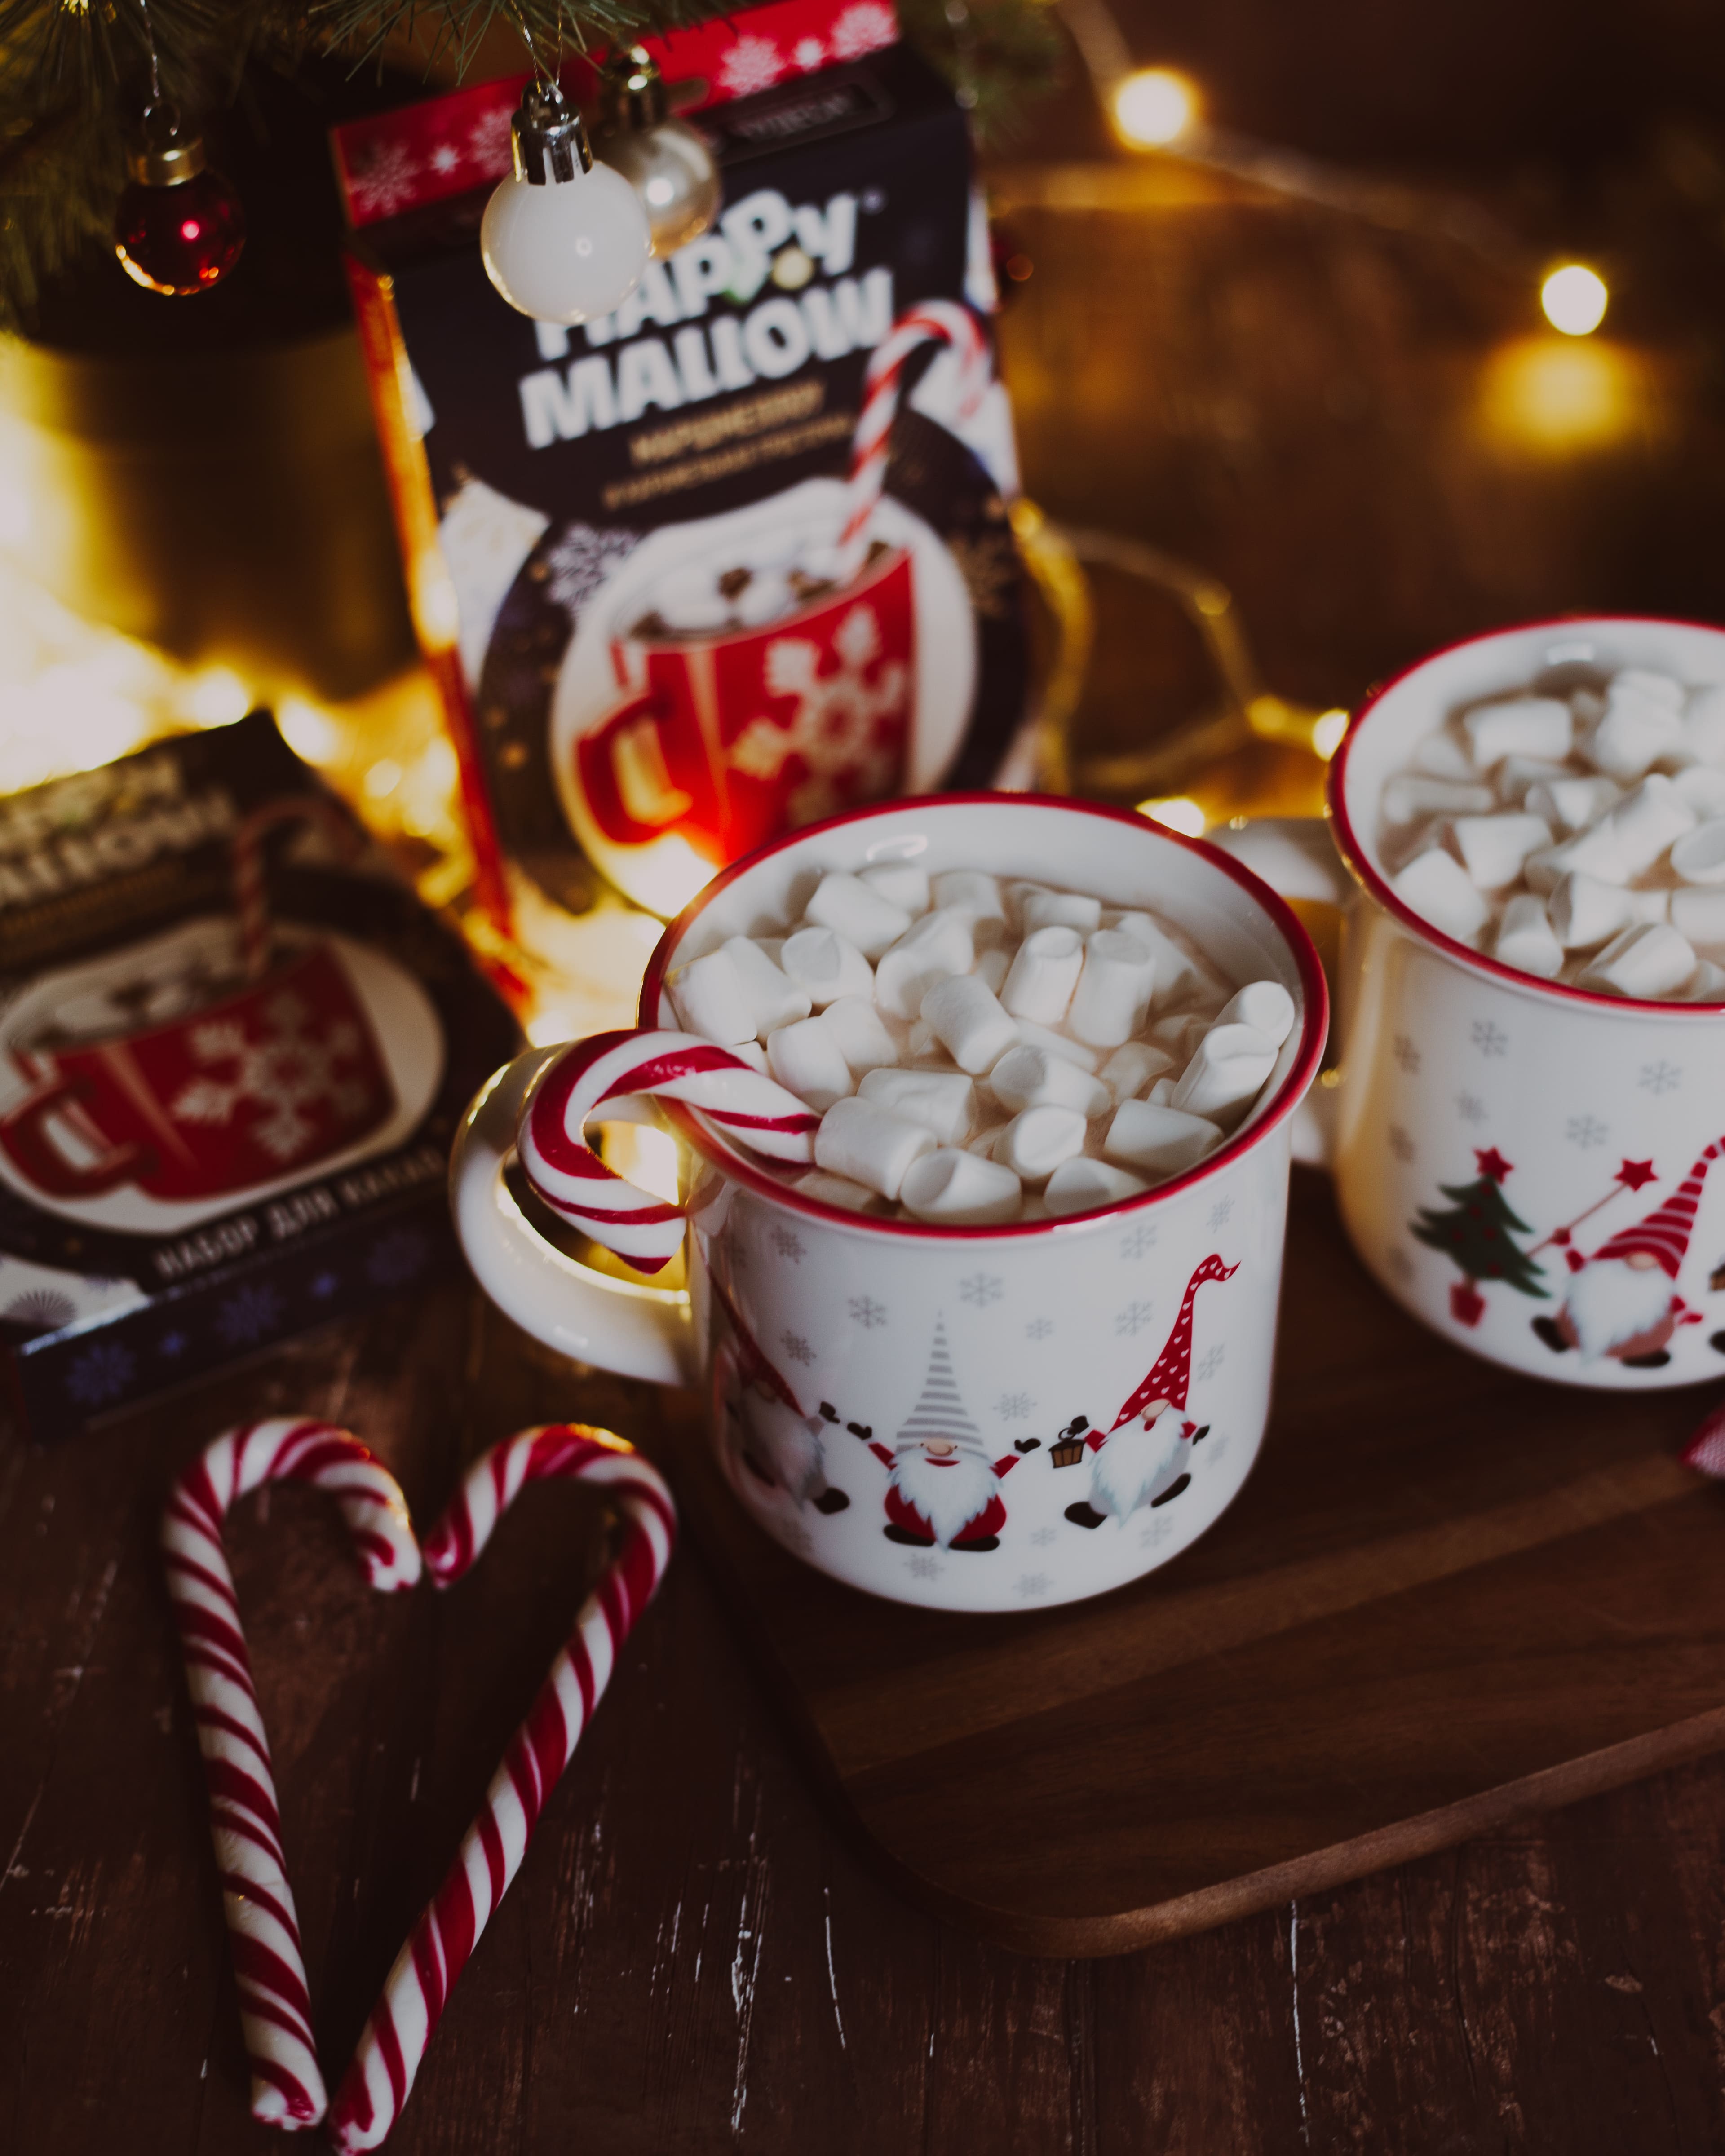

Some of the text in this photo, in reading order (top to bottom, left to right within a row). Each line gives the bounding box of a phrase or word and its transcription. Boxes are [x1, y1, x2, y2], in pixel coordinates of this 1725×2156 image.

[519, 268, 894, 448] MALLOW
[154, 1215, 259, 1279] НАБОР
[270, 1187, 341, 1239] ДЛЯ
